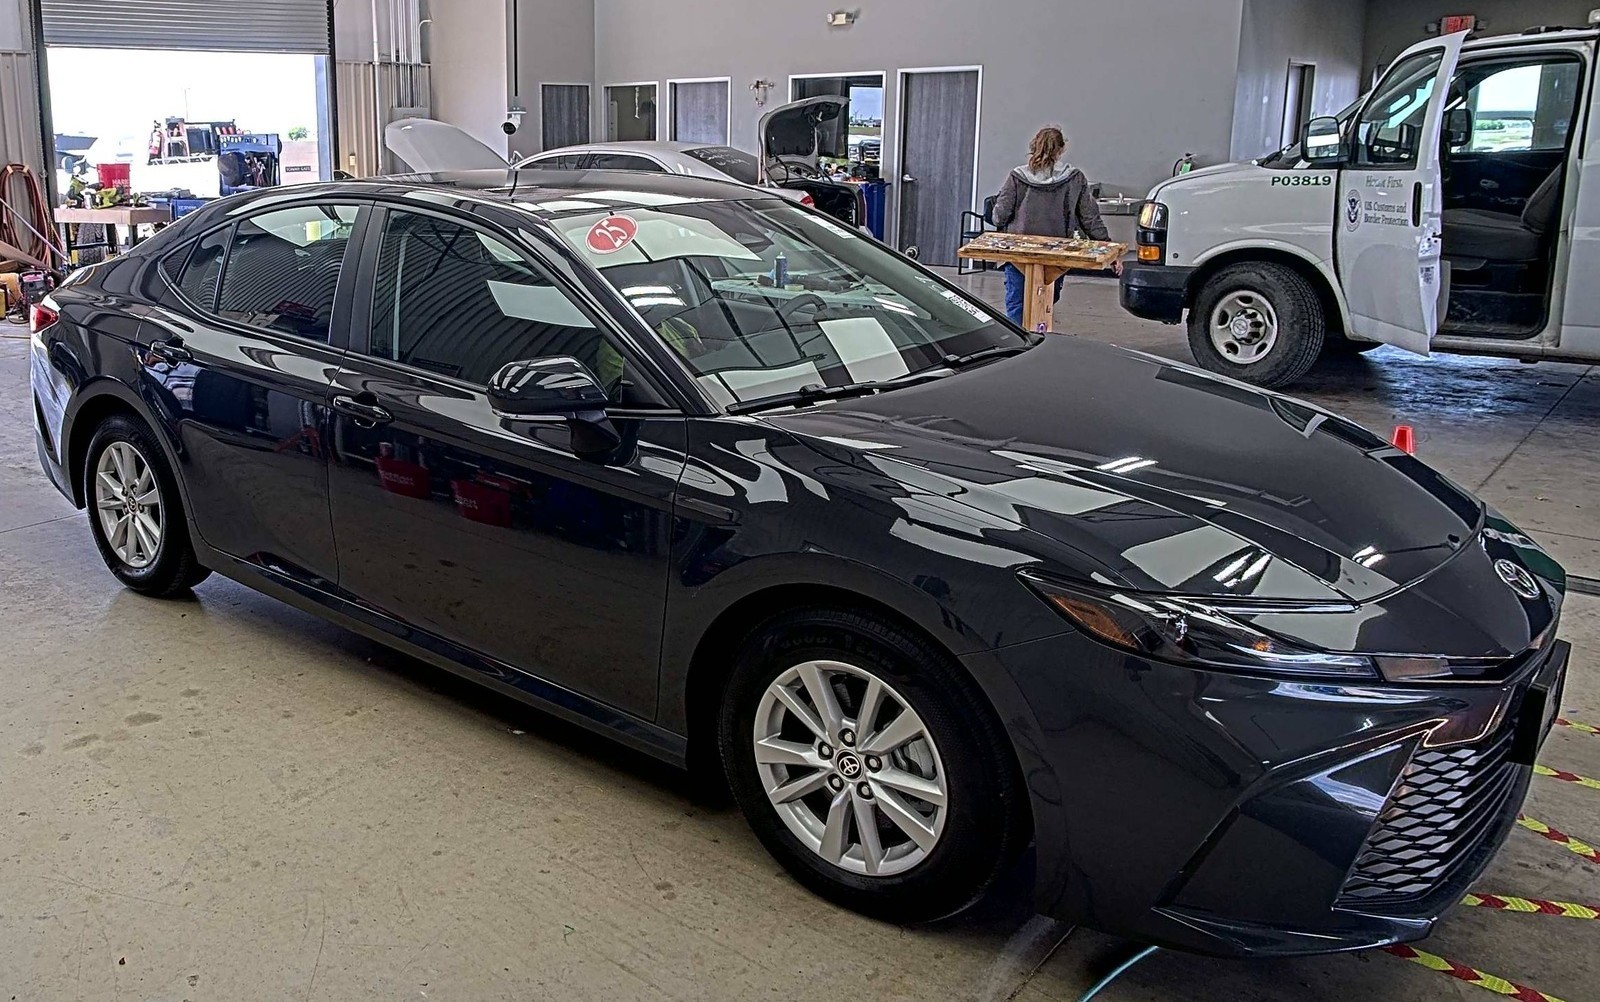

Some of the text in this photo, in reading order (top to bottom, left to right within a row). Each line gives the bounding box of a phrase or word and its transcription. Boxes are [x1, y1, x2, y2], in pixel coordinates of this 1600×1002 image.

[1271, 175, 1331, 186] P03819
[1373, 202, 1395, 212] Customs
[1396, 202, 1407, 213] and
[1364, 213, 1409, 227] Border Protection
[595, 220, 627, 248] 25
